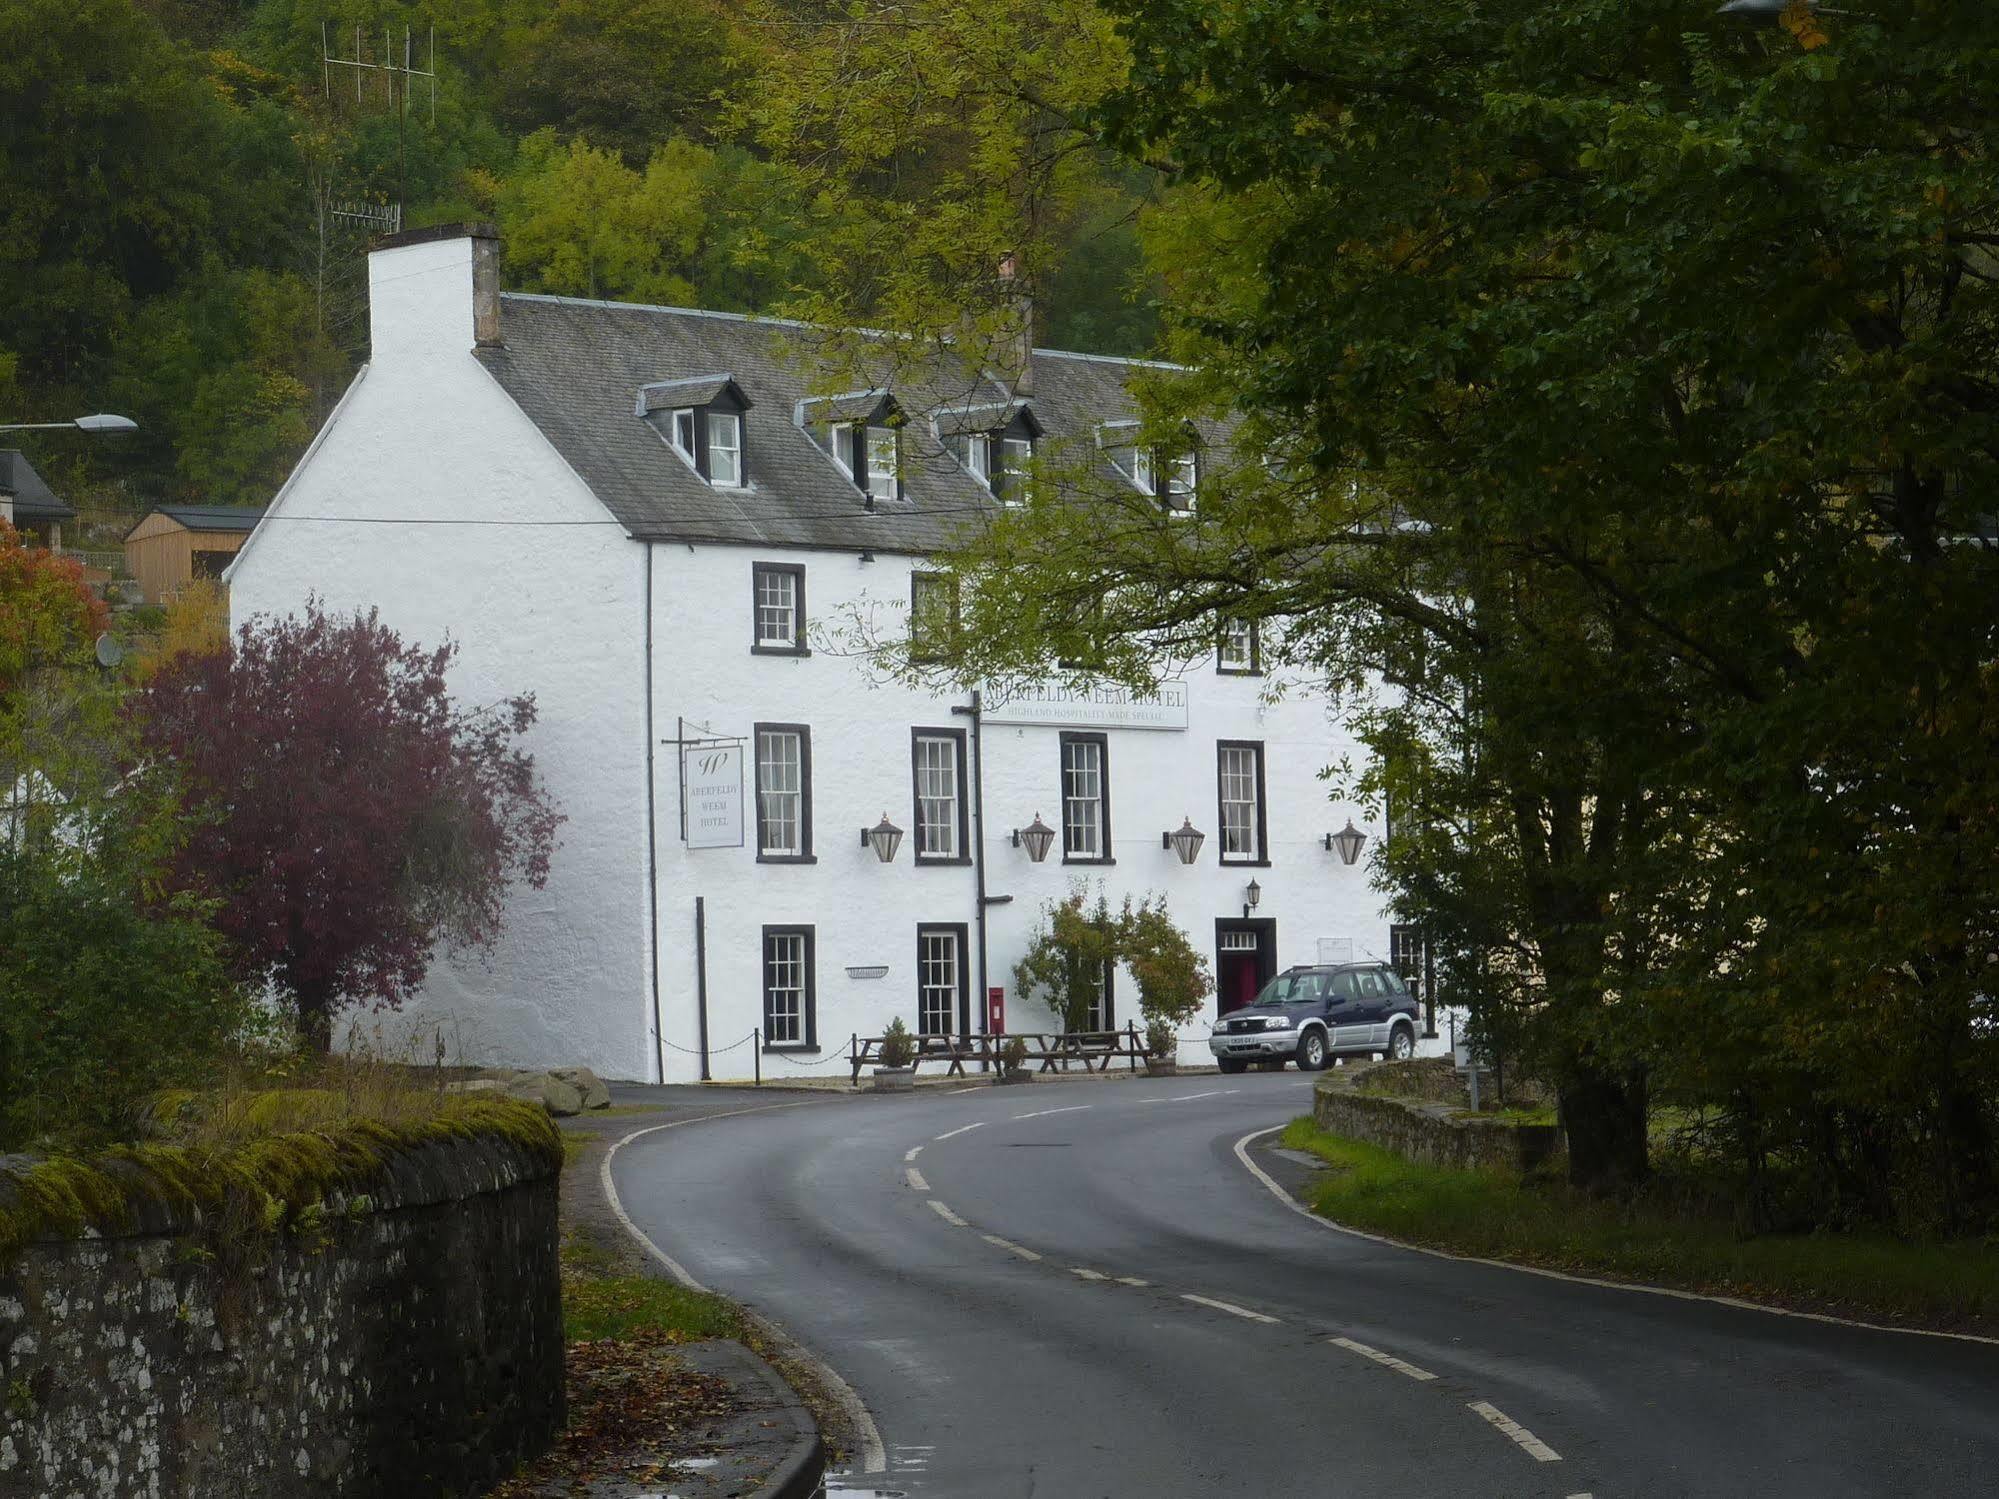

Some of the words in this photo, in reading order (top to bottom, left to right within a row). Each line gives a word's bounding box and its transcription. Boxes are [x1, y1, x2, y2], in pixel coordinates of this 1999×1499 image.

[691, 784, 737, 797] ABERFELDY
[702, 802, 727, 812] WEEM
[701, 817, 728, 827] HOTEL
